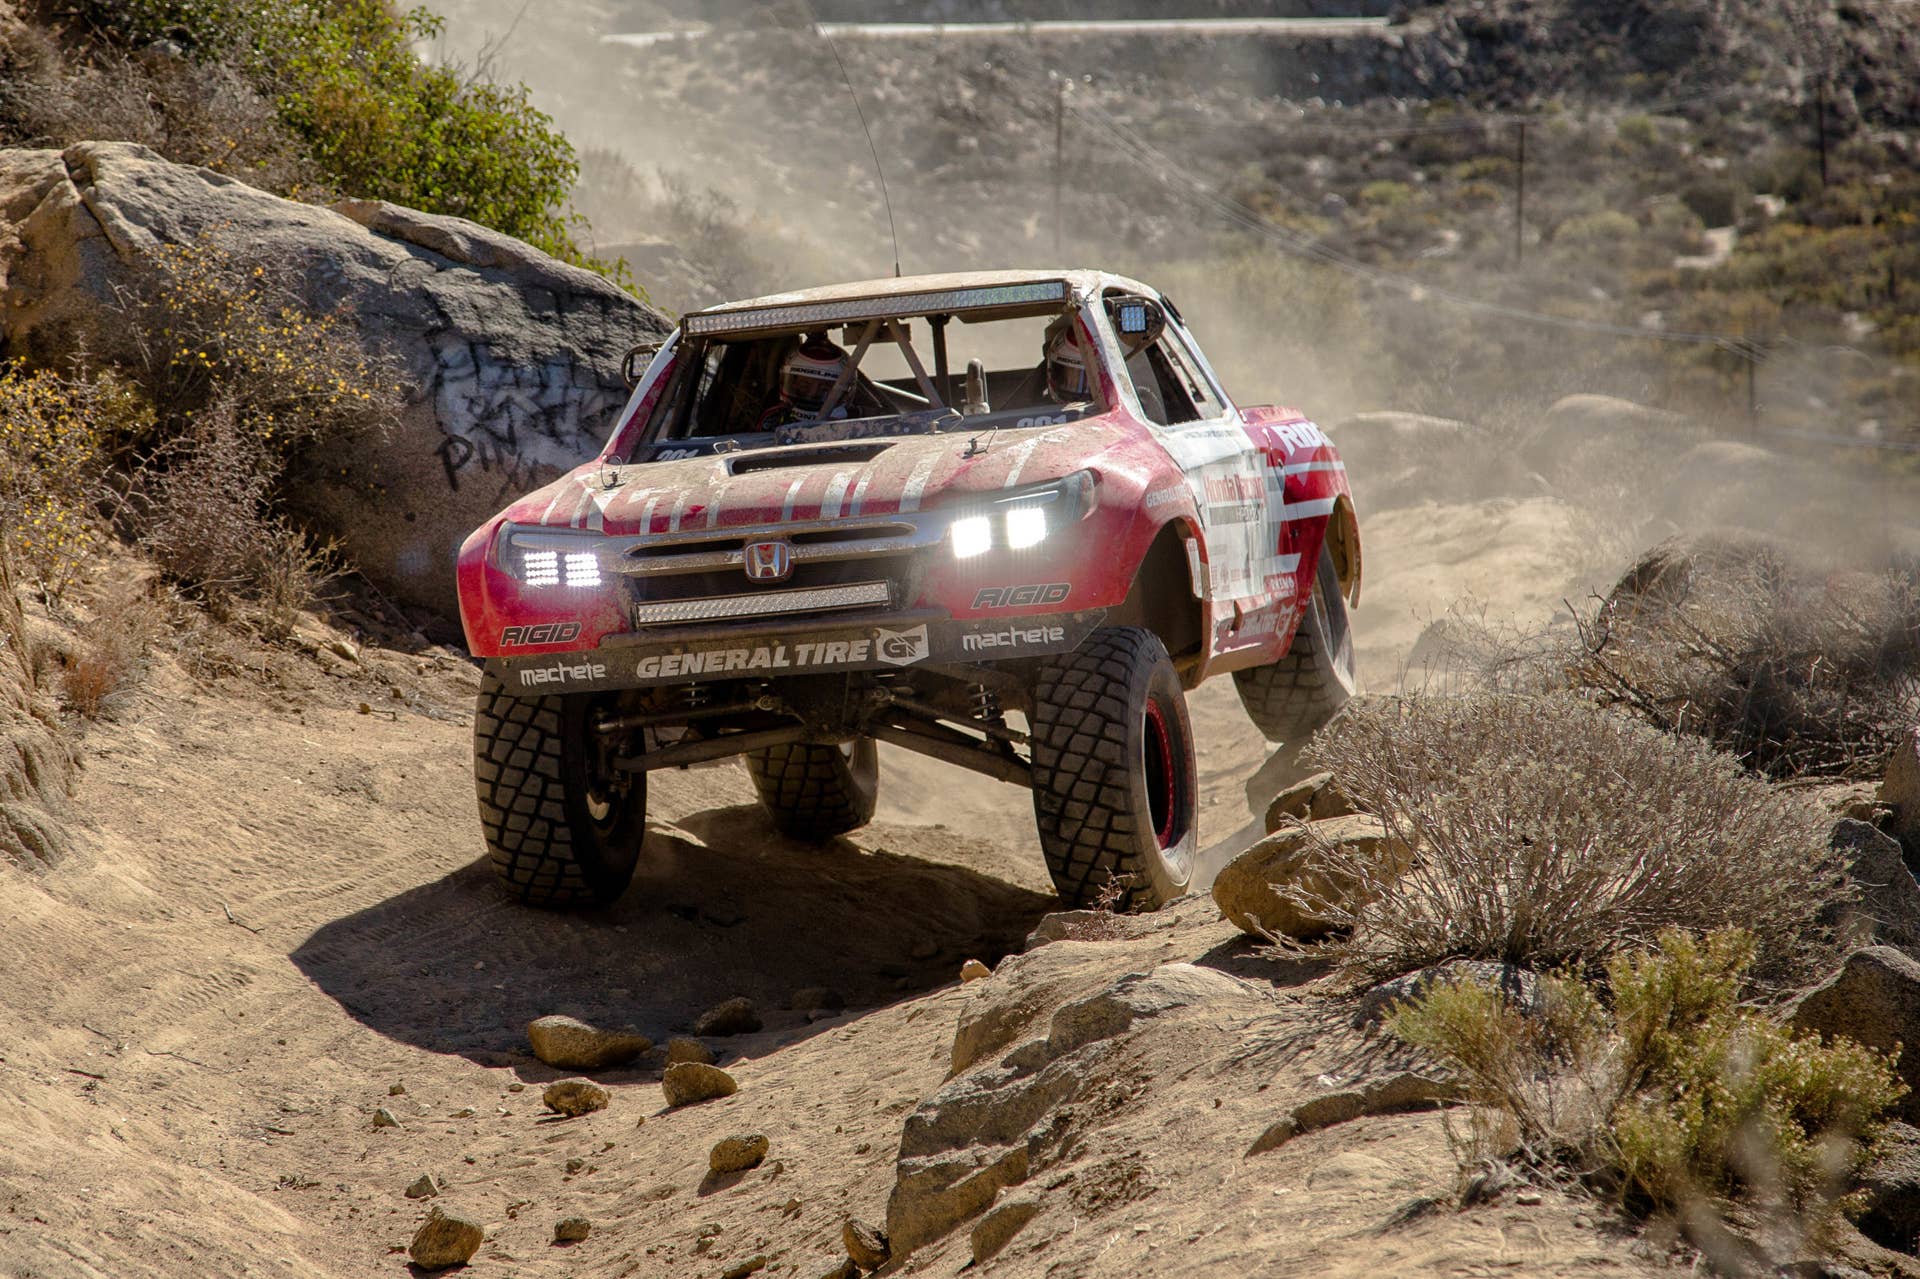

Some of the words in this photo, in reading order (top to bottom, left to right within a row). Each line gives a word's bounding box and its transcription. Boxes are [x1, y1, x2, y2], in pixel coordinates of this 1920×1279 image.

[970, 582, 1072, 609] RIGID
[500, 622, 582, 647] RIGID
[962, 625, 1064, 651] machete
[636, 648, 791, 679] GENERAL
[794, 640, 871, 666] TIRE
[520, 662, 607, 686] machete
